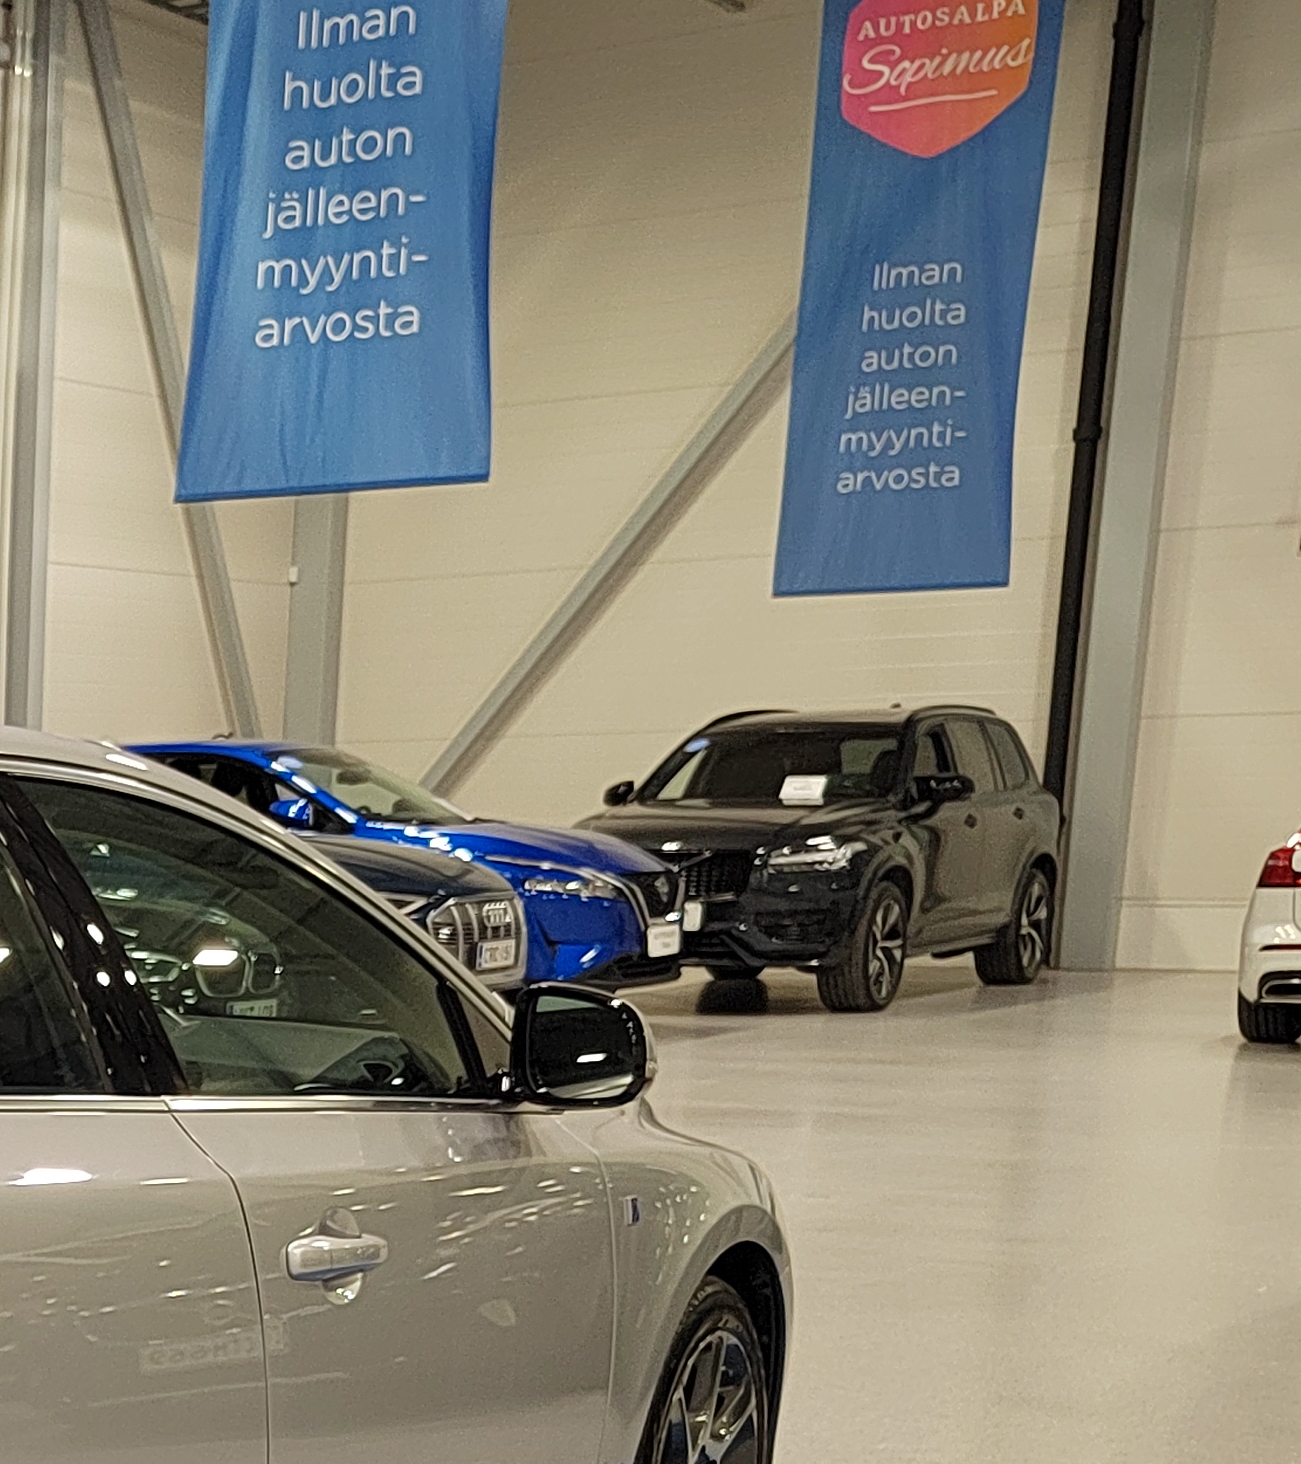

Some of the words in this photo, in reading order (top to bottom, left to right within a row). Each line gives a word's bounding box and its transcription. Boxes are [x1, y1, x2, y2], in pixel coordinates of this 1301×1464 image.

[298, 4, 416, 50] Ilman
[857, 0, 1026, 41] AUTOSALPA
[283, 59, 424, 111] huolta
[284, 125, 413, 170] auton
[263, 185, 427, 239] jälleen-
[257, 237, 429, 295] myynti-
[873, 260, 963, 291] Ilman
[254, 300, 421, 348] arvosta
[862, 299, 967, 333] huolta
[861, 343, 957, 373] auton
[844, 383, 967, 419] jälleen-
[838, 419, 967, 458] myynti-
[836, 461, 961, 494] arvosta
